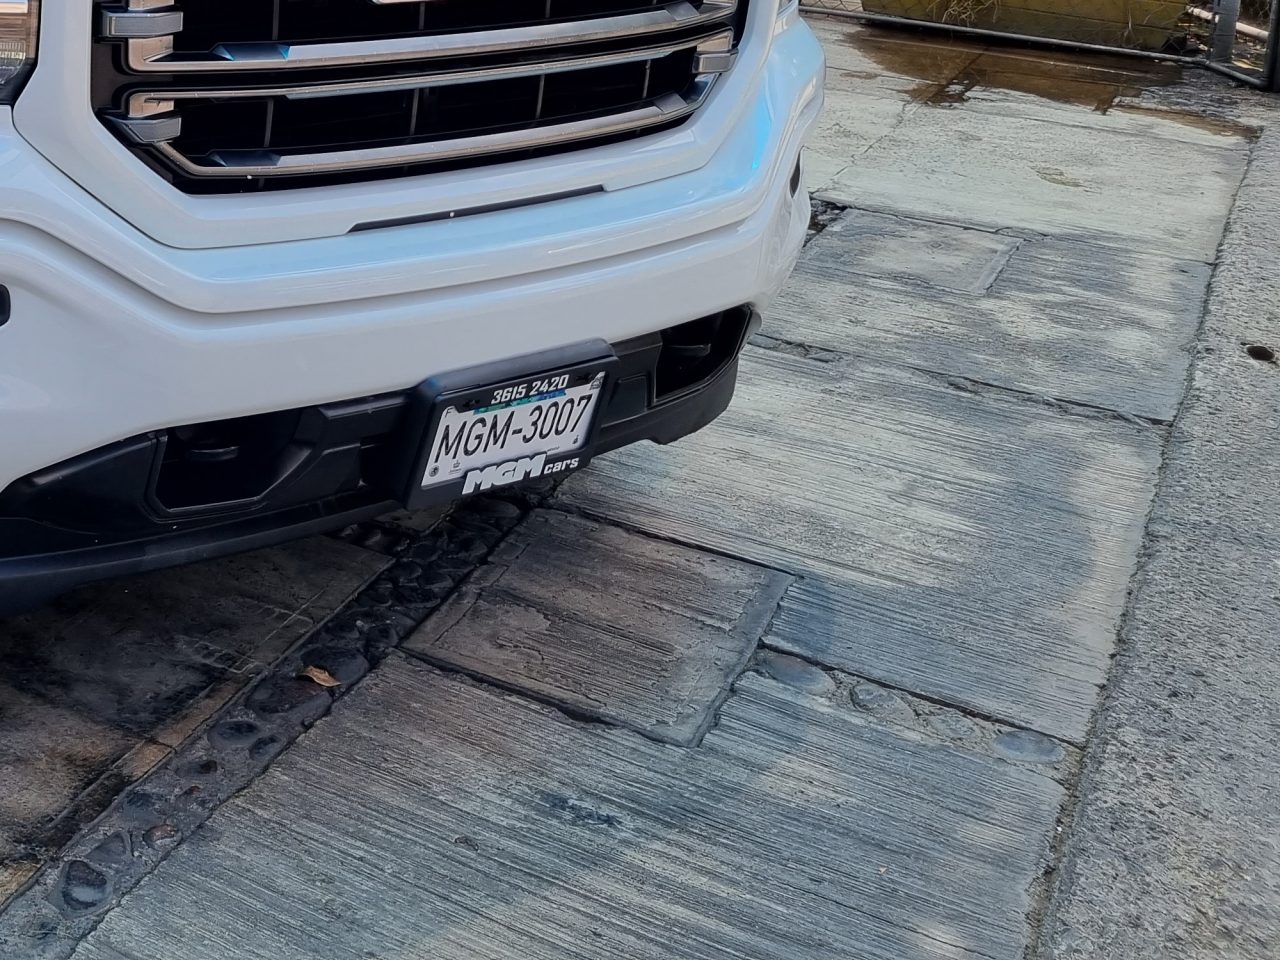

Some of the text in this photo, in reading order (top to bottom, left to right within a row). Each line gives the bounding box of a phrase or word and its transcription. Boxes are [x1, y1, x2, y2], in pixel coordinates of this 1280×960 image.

[491, 384, 528, 405] 3615
[529, 374, 570, 396] 2420
[434, 394, 594, 464] MGM-3007
[461, 453, 581, 496] MGM cars
